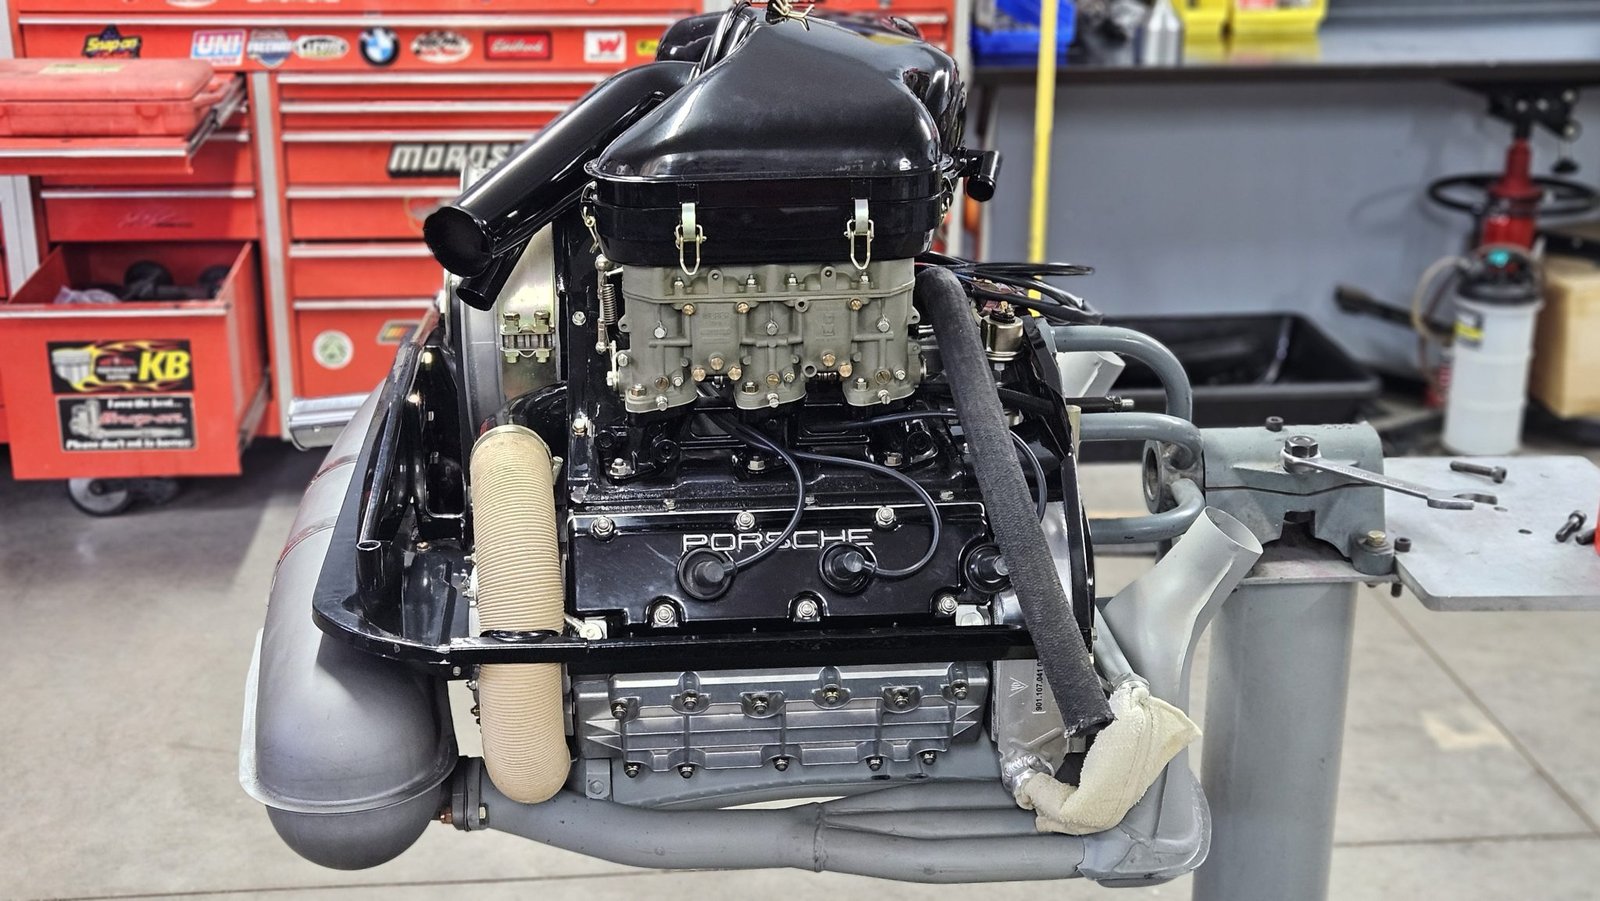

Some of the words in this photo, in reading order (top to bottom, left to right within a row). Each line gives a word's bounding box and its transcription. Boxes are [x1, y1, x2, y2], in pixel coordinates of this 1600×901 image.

[198, 33, 240, 55] UNI
[390, 144, 523, 172] MOROS
[139, 350, 190, 381] KB
[65, 439, 99, 450] Please
[682, 528, 876, 552] PORSCHE
